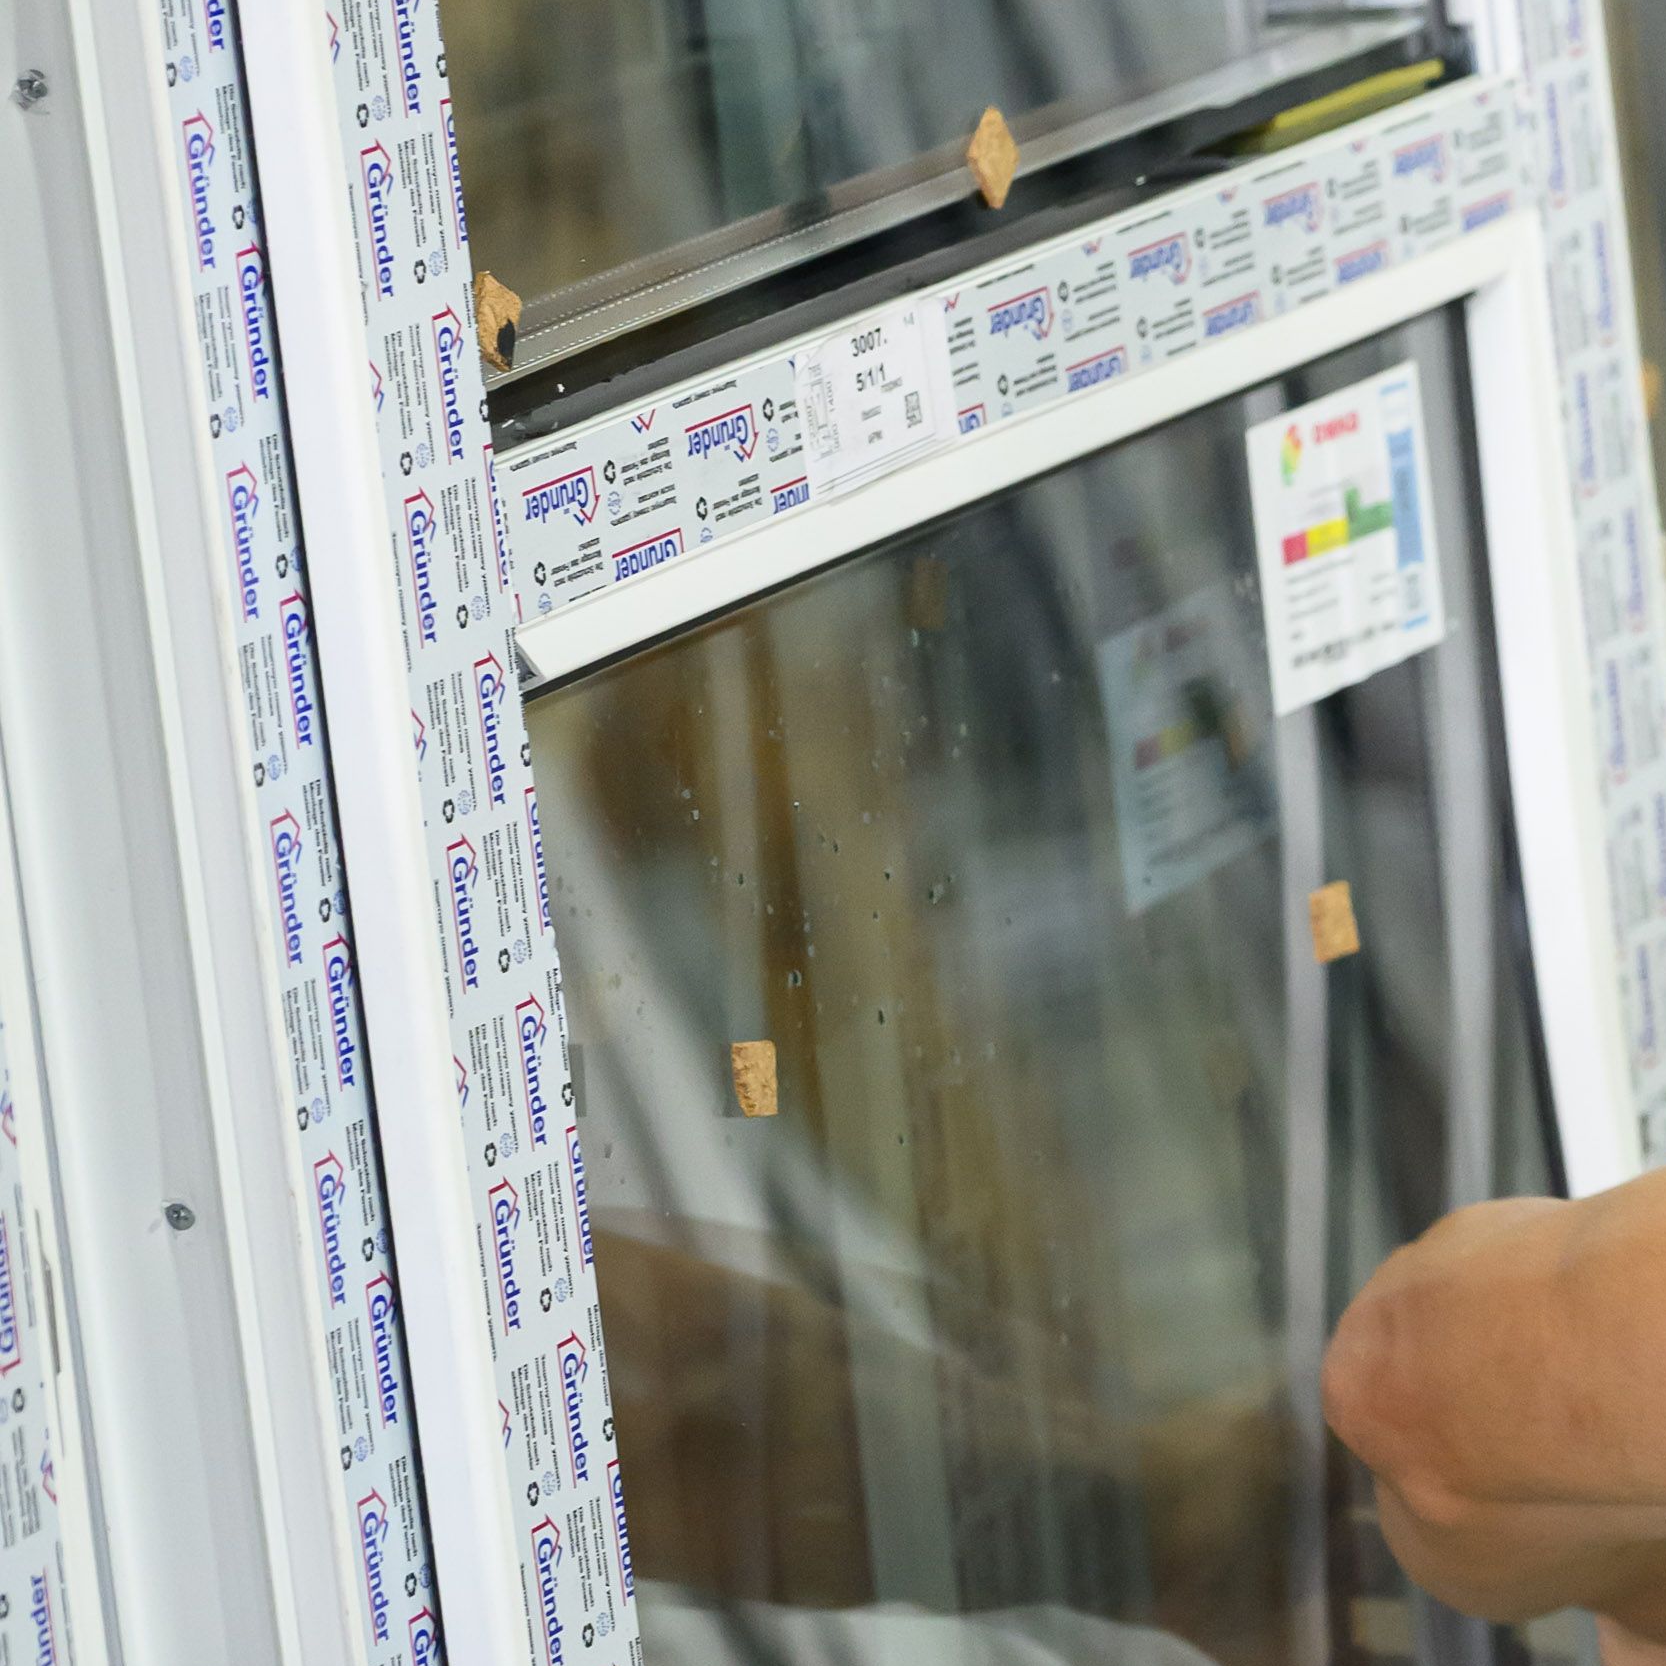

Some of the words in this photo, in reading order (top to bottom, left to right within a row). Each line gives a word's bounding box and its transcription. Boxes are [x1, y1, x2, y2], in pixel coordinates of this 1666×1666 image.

[189, 132, 218, 271] Gründer
[368, 162, 395, 296] Gründer
[242, 264, 269, 400] Gründer
[438, 327, 465, 460] Gründer
[851, 327, 888, 358] 3007.
[855, 361, 887, 393] 5/1/1
[525, 477, 590, 525] Gründer
[687, 413, 750, 460] Gründer
[233, 484, 261, 621] Gründer
[411, 510, 438, 643] Gründer
[286, 612, 313, 751] Gründer
[480, 674, 507, 804] Gründer
[276, 831, 305, 965] Gründer
[453, 856, 480, 988] Gründer
[329, 953, 355, 1087] Gründer
[522, 1014, 548, 1145] Gründer
[320, 1172, 347, 1305] Gründer
[495, 1199, 521, 1329] Gründer
[372, 1290, 399, 1424] Gründer
[564, 1352, 589, 1482] Gründer
[363, 1511, 391, 1643] Gründer
[537, 1536, 564, 1666] Gründer
